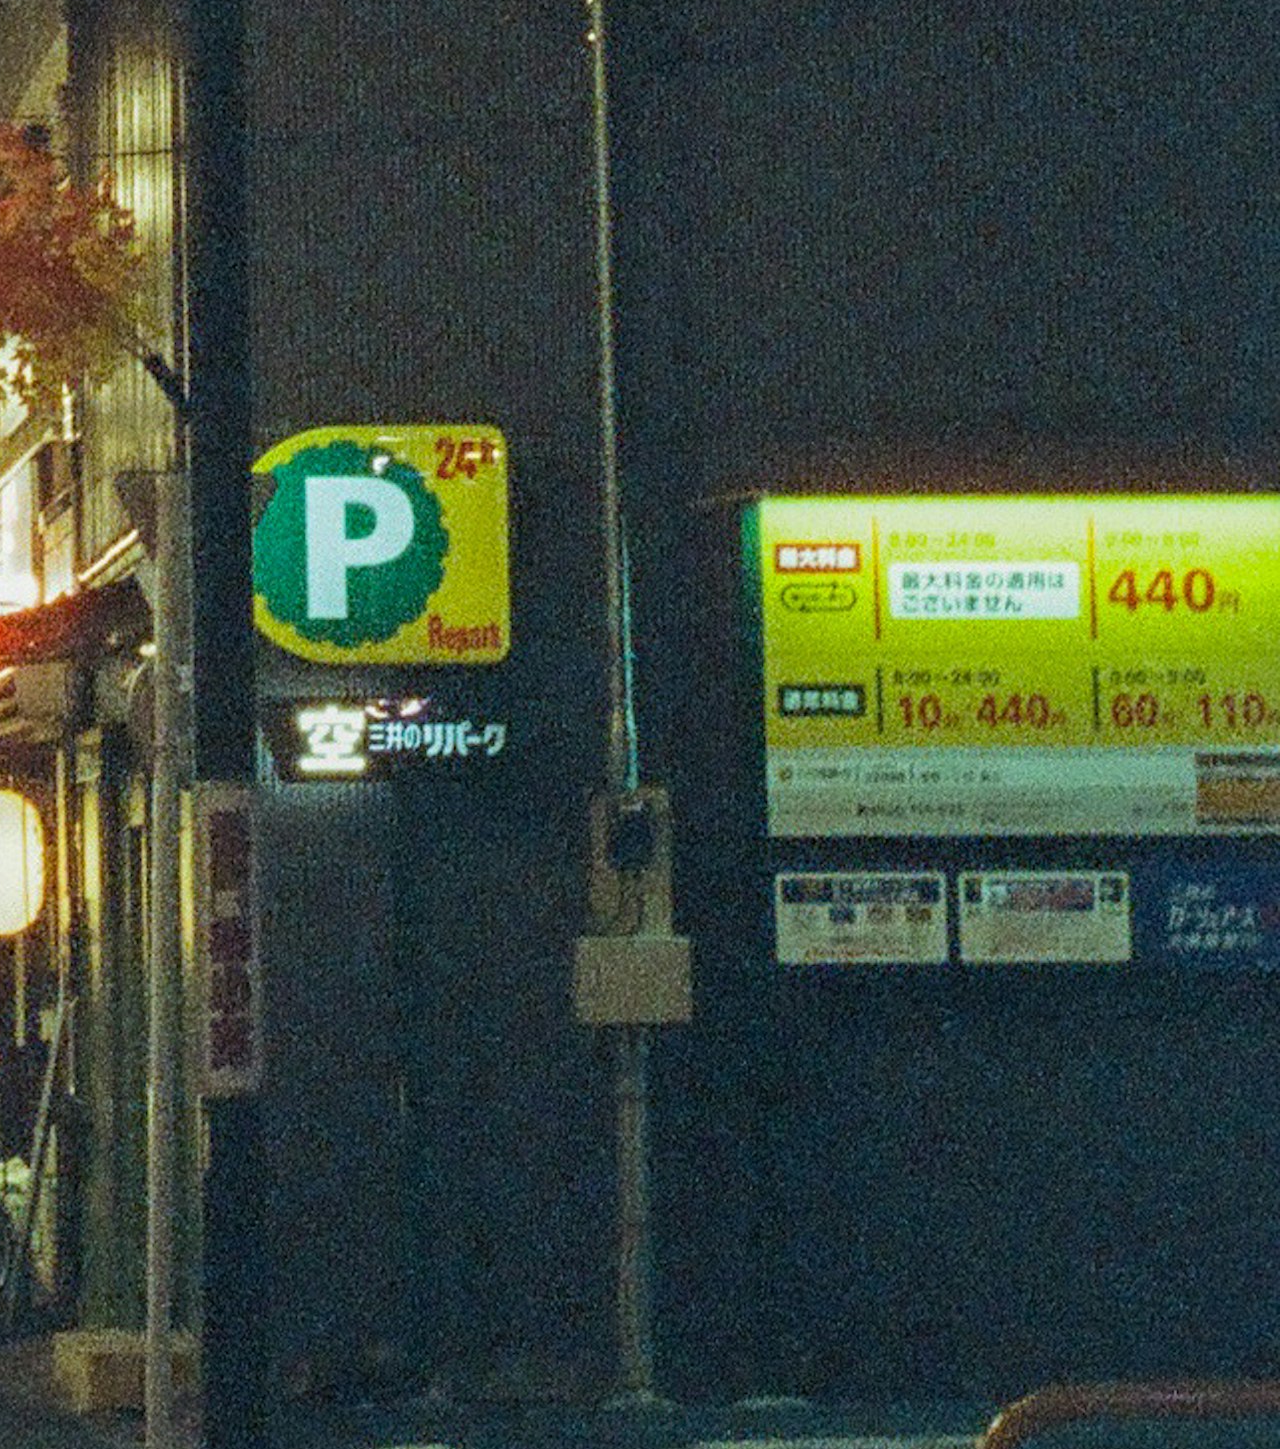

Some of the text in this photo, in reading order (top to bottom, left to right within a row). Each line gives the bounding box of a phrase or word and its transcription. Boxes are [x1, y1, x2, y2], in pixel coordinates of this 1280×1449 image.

[304, 475, 415, 620] P
[296, 704, 367, 773] 空
[367, 720, 507, 757] 三井のリパーク
